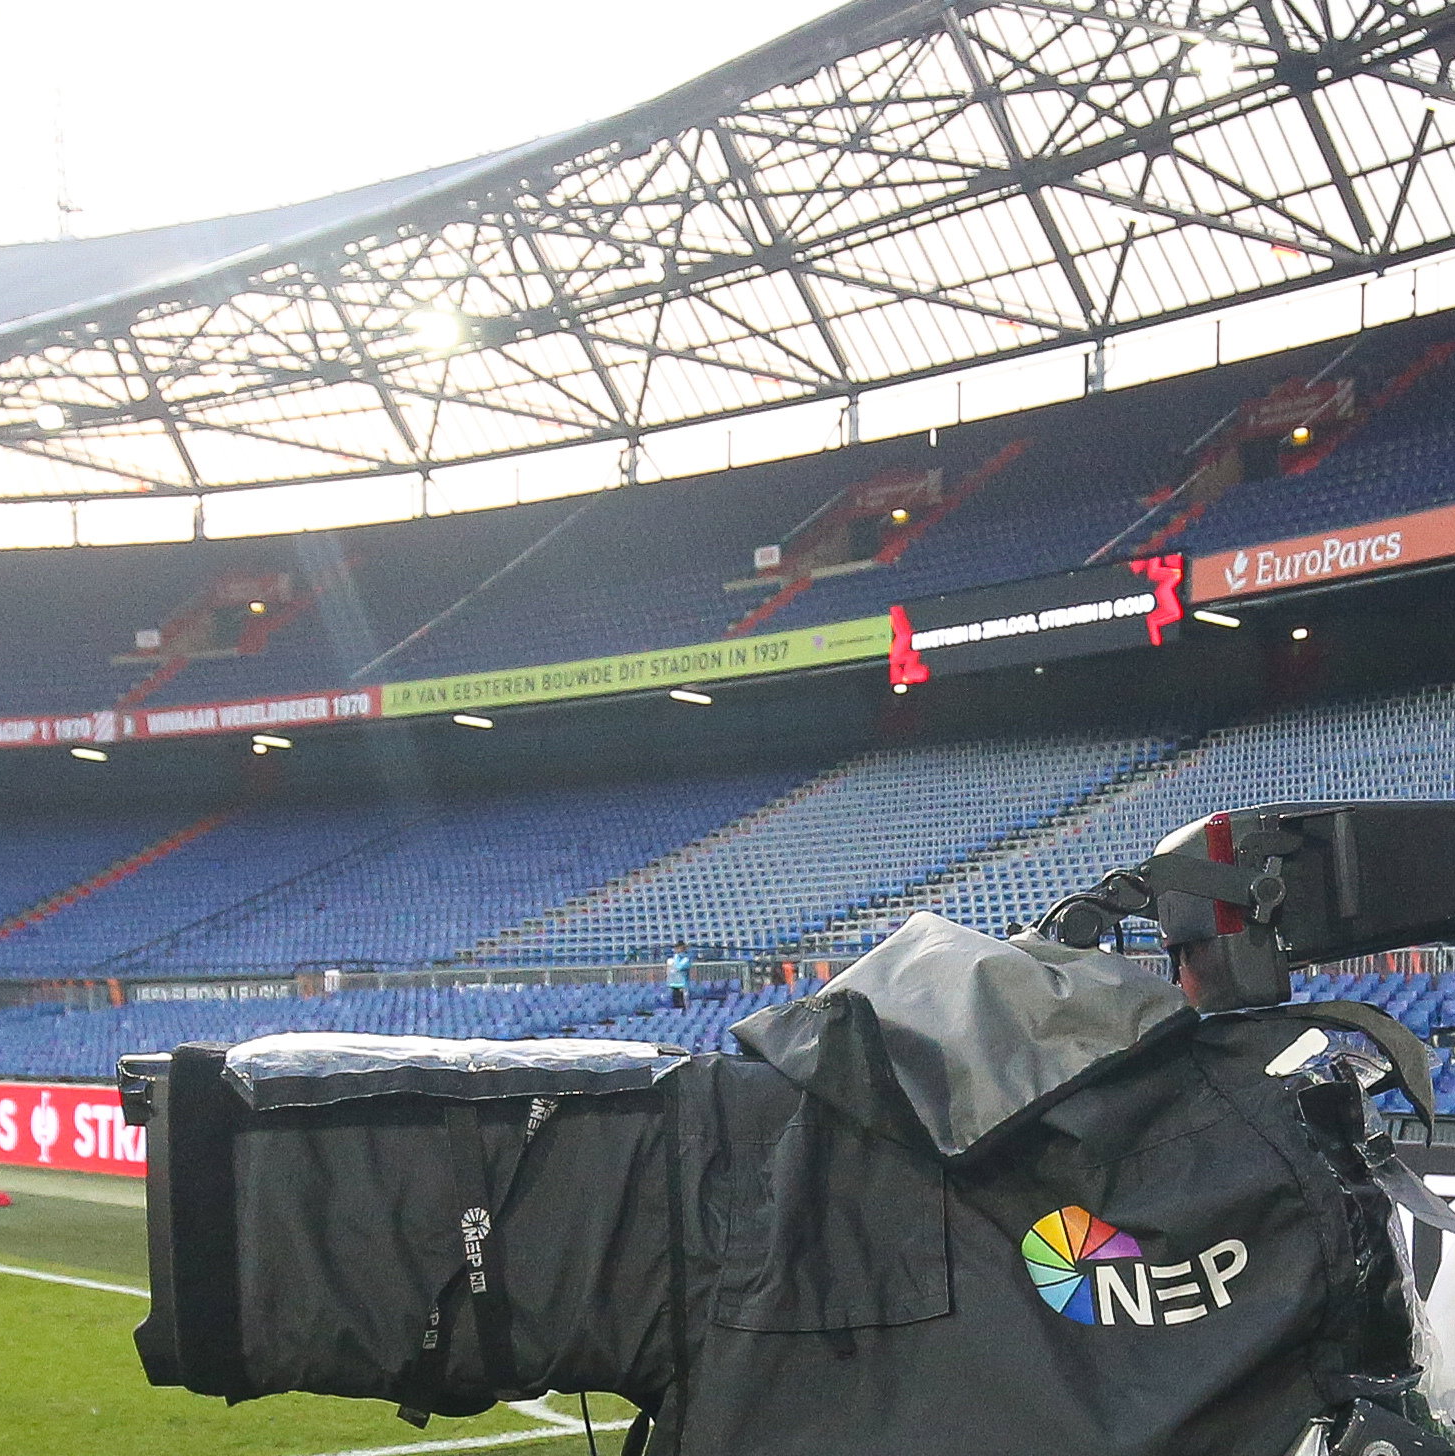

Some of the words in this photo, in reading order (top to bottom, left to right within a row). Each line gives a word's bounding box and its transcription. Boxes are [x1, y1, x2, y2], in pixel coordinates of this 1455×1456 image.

[1254, 532, 1403, 587] EuroParcs
[649, 650, 724, 678] STADION
[1095, 1238, 1249, 1326] NEP
